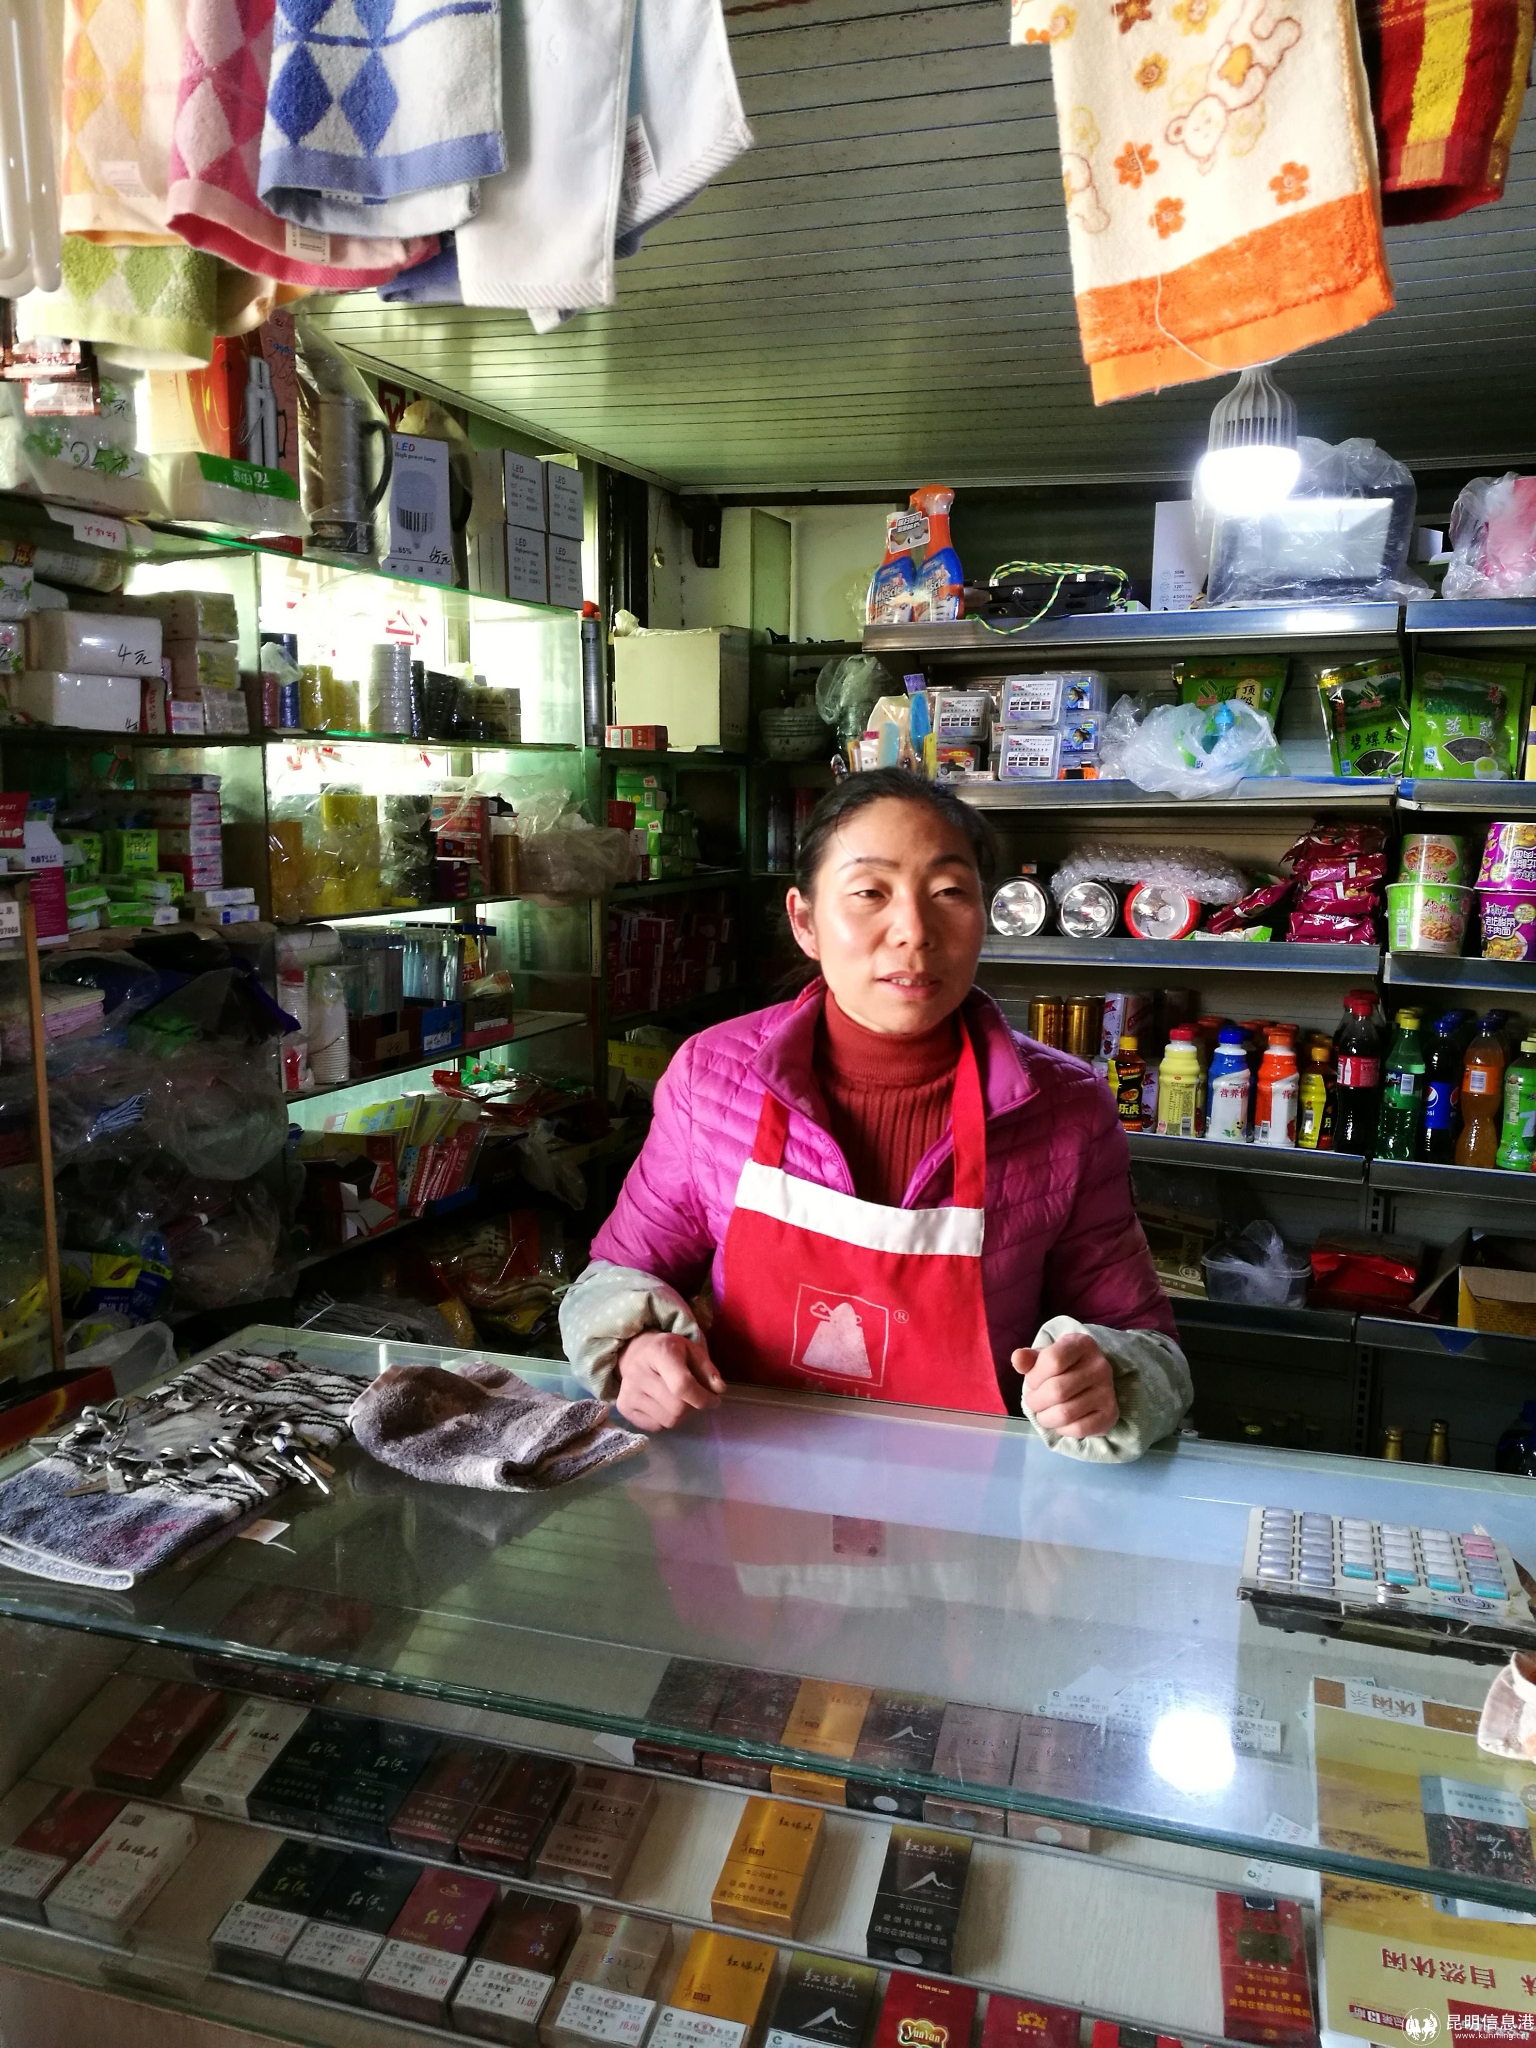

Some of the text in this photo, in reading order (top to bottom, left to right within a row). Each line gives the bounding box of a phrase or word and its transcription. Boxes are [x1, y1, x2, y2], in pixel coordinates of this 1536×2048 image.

[395, 442, 416, 452] LED
[512, 463, 524, 473] LED
[555, 475, 566, 485] LED
[515, 537, 527, 547] LED
[555, 546, 566, 556] LED
[876, 586, 904, 600] Muscle
[1351, 727, 1402, 752] 碧螺春
[1487, 926, 1511, 936] 牛肉面
[1119, 1104, 1140, 1115] 乐虎
[591, 1799, 635, 1818] 红塔山
[778, 1816, 813, 1831] 红塔山
[904, 1838, 953, 1858] 红塔山
[727, 1955, 765, 1973] 红塔山
[1381, 1948, 1497, 1989] 自然休闲
[804, 1968, 856, 1990] 红塔山
